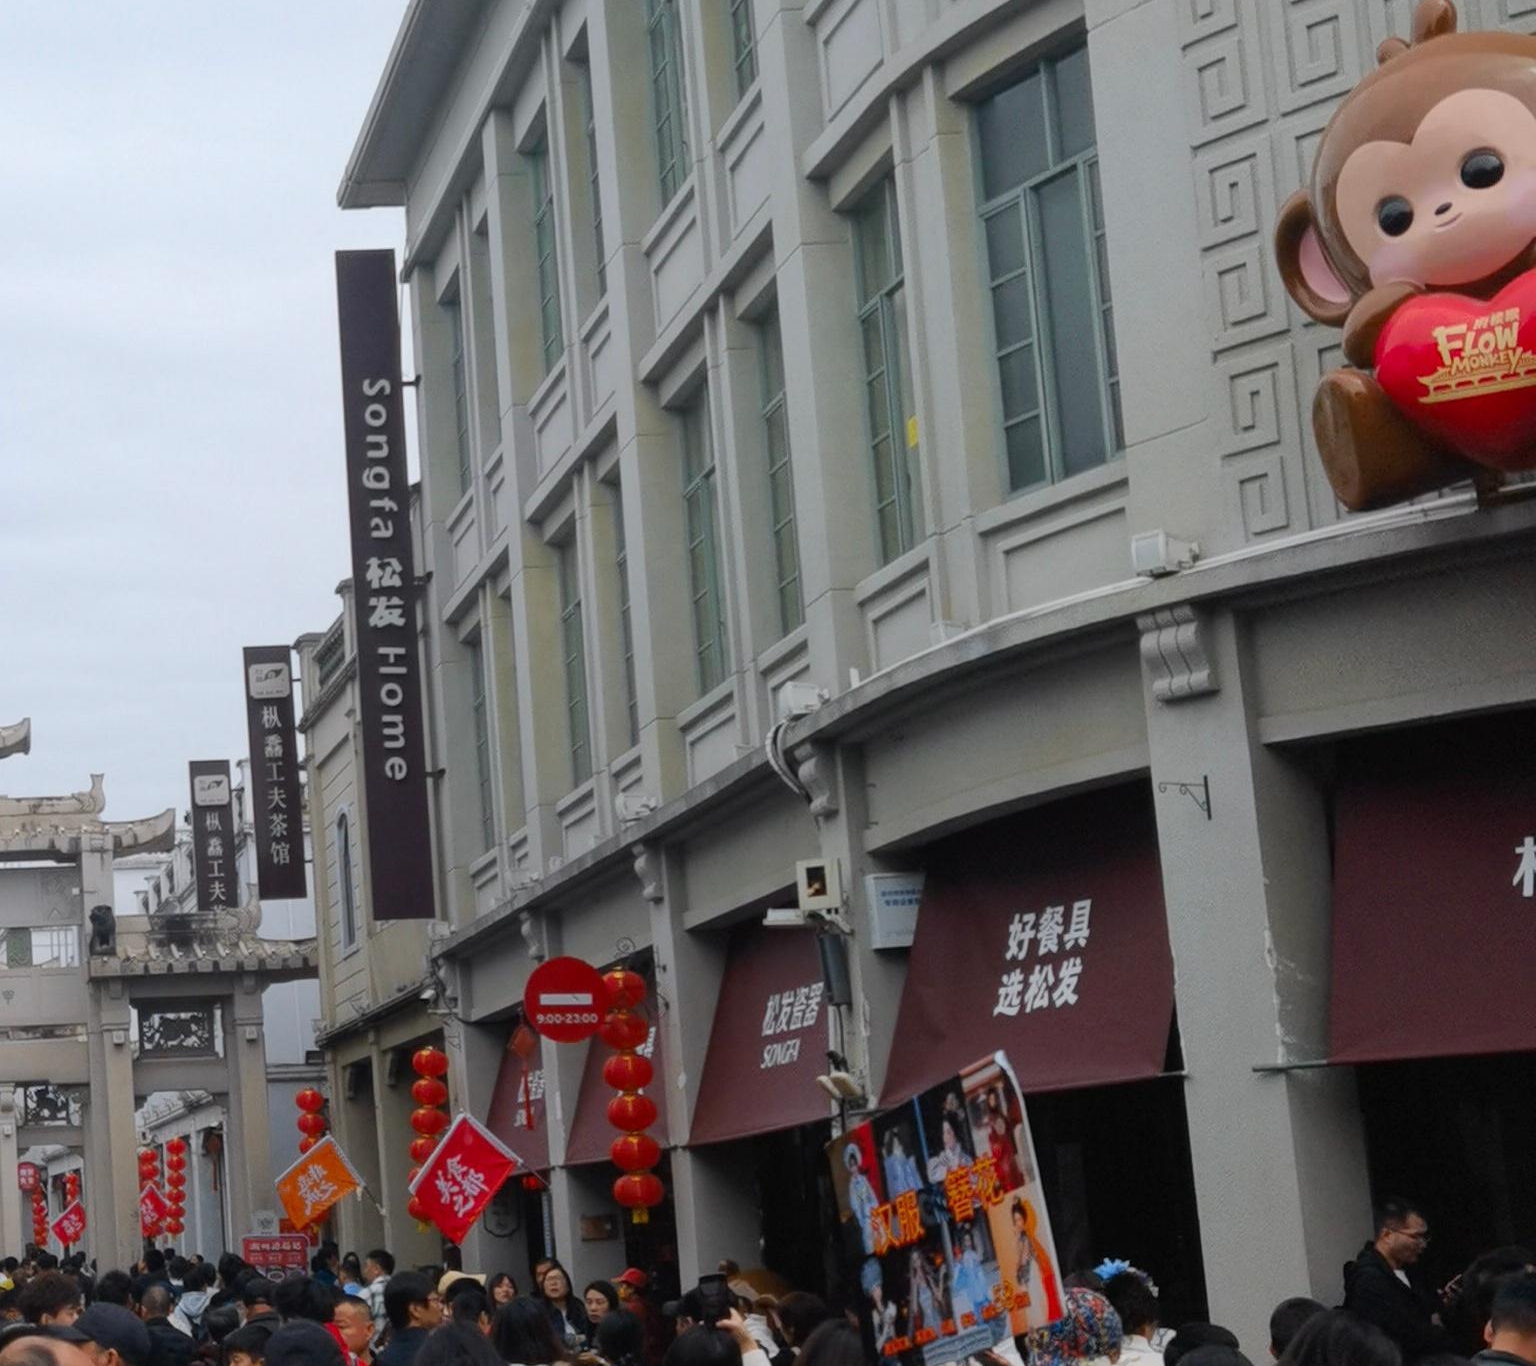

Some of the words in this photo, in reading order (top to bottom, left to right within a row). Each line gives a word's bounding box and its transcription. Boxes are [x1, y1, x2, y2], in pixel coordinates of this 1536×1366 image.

[1432, 323, 1520, 366] FLOW
[1451, 347, 1524, 376] MONKEY
[362, 378, 398, 539] Songfa
[366, 556, 407, 629] 松发
[377, 645, 408, 781] Home
[1005, 899, 1092, 961] 好餐具
[761, 982, 825, 1037] 松发瓷器
[992, 956, 1083, 1017] 选松发
[536, 1013, 599, 1025] 9:00-23:00
[871, 1189, 925, 1257] 汉服
